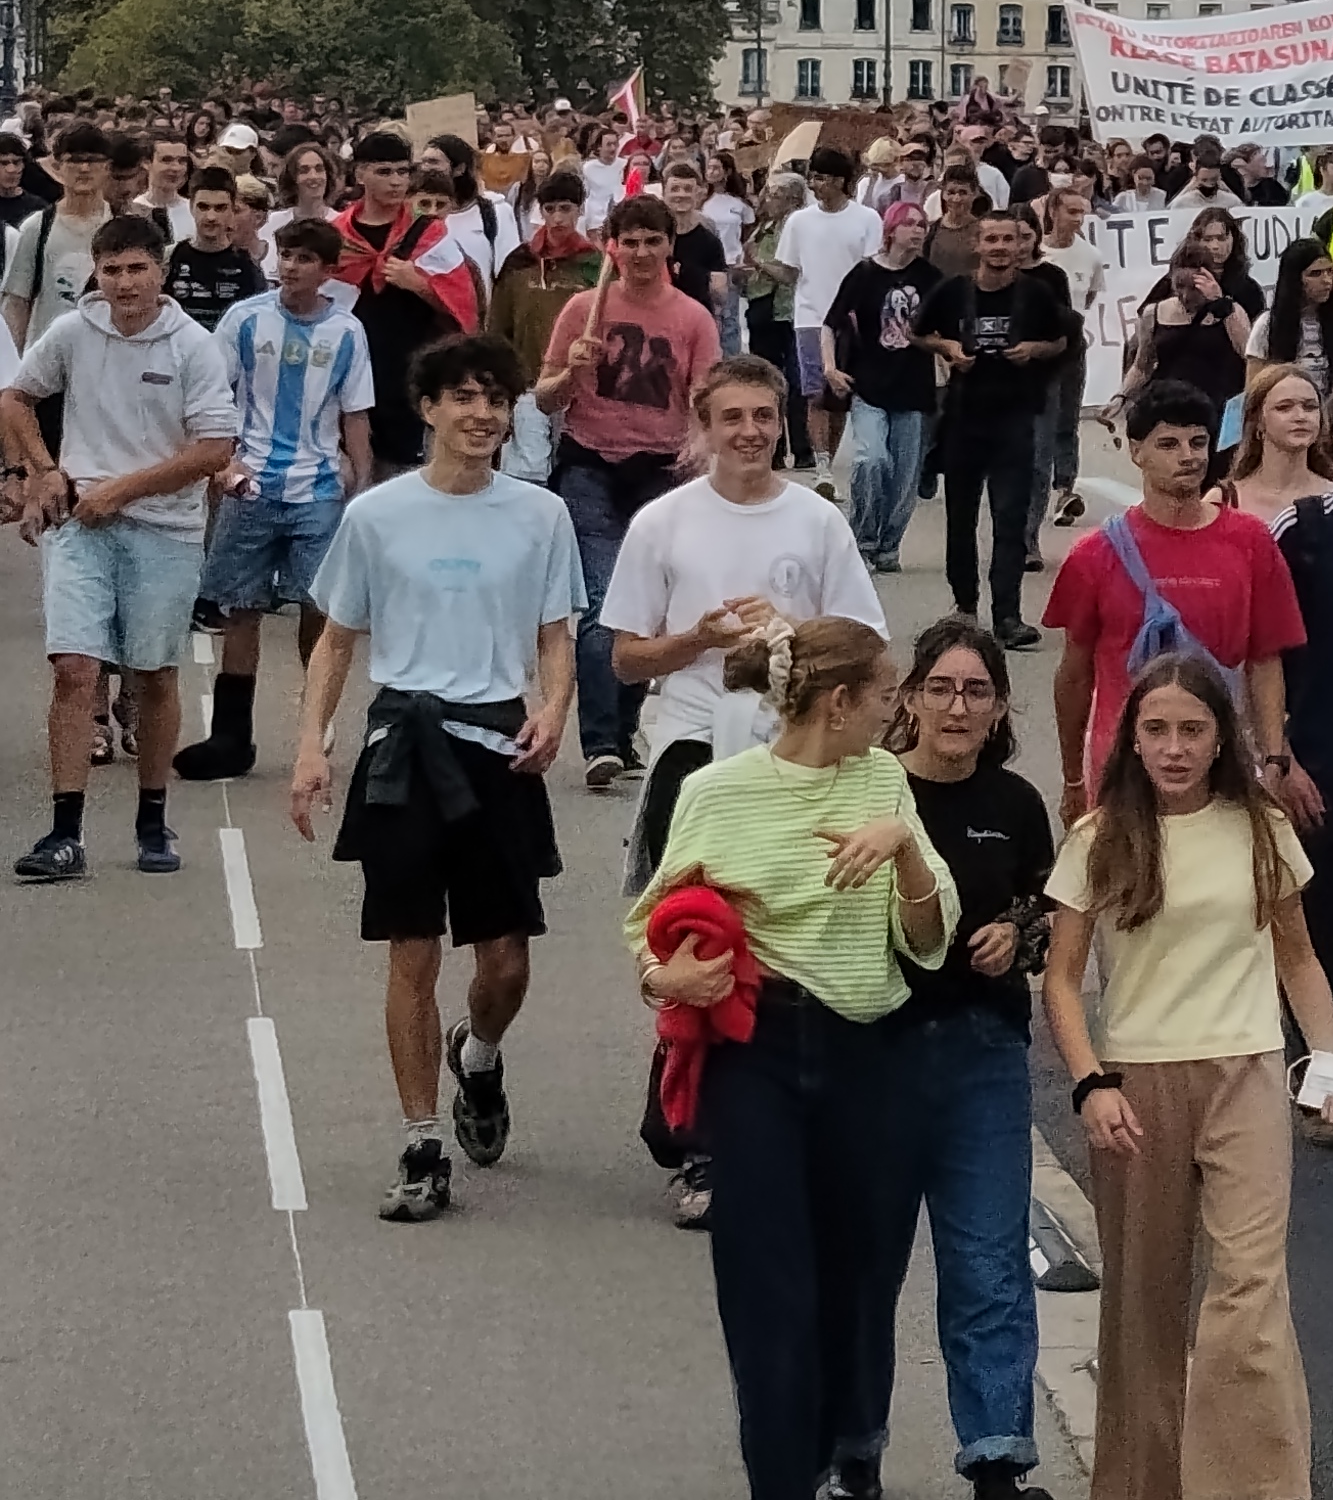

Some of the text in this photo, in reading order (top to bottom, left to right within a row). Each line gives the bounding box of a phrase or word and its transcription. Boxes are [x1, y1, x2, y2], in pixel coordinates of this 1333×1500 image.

[1111, 71, 1196, 107] UNITÉ
[1204, 87, 1241, 107] DE
[1095, 105, 1166, 124] ONTRE
